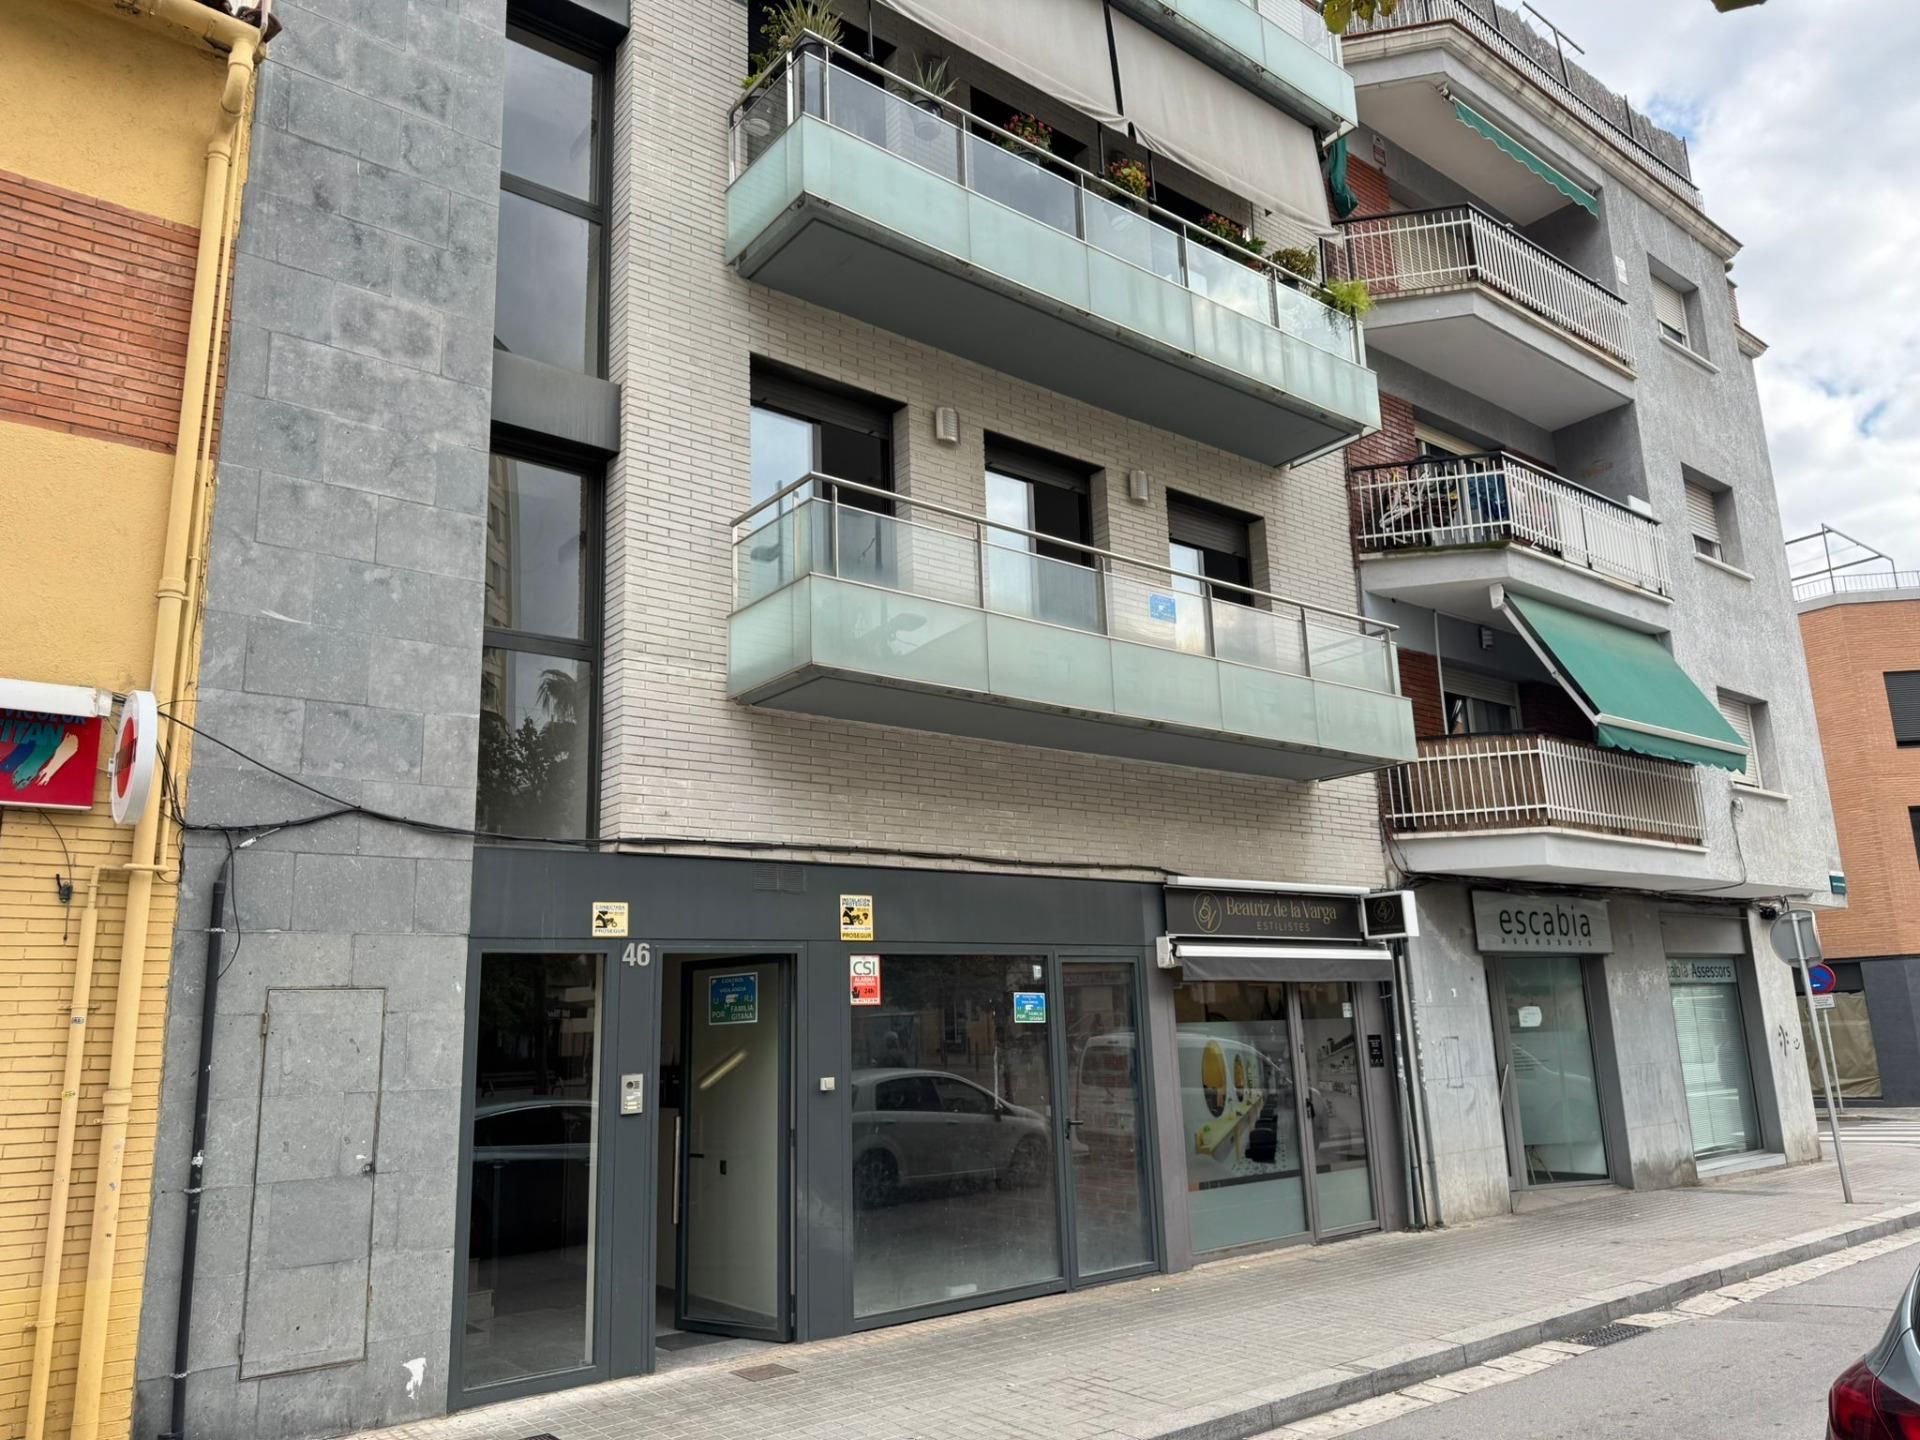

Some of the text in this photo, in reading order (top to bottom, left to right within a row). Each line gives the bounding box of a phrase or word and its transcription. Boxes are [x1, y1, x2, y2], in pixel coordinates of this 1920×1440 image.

[0, 719, 65, 746] ITAN
[1226, 896, 1337, 925] Beatriz de la Varga
[1257, 921, 1311, 932] ESTILISTES
[1499, 904, 1592, 937] escabia
[622, 942, 650, 967] 46
[853, 961, 876, 976] CSI
[1691, 963, 1732, 978] Assessors
[712, 1010, 726, 1019] POR
[730, 1004, 754, 1013] FAMILIA
[730, 1011, 754, 1020] GITANA
